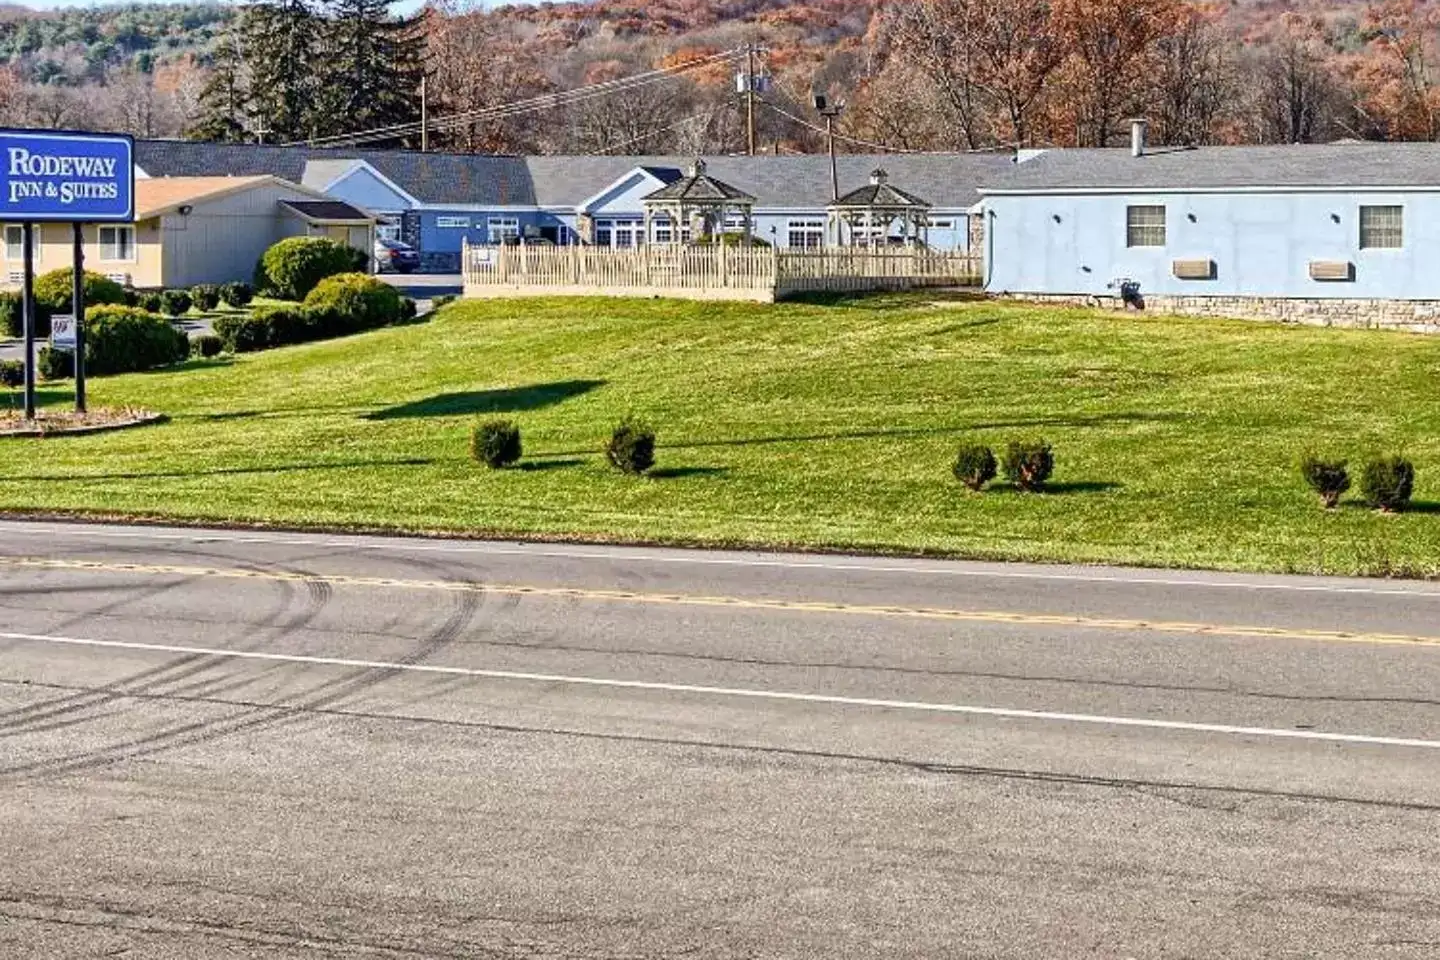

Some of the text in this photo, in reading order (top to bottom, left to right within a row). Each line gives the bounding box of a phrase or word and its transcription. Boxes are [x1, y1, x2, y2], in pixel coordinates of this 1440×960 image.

[8, 147, 116, 177] RODEWAY
[9, 180, 118, 204] INN & SUITES
